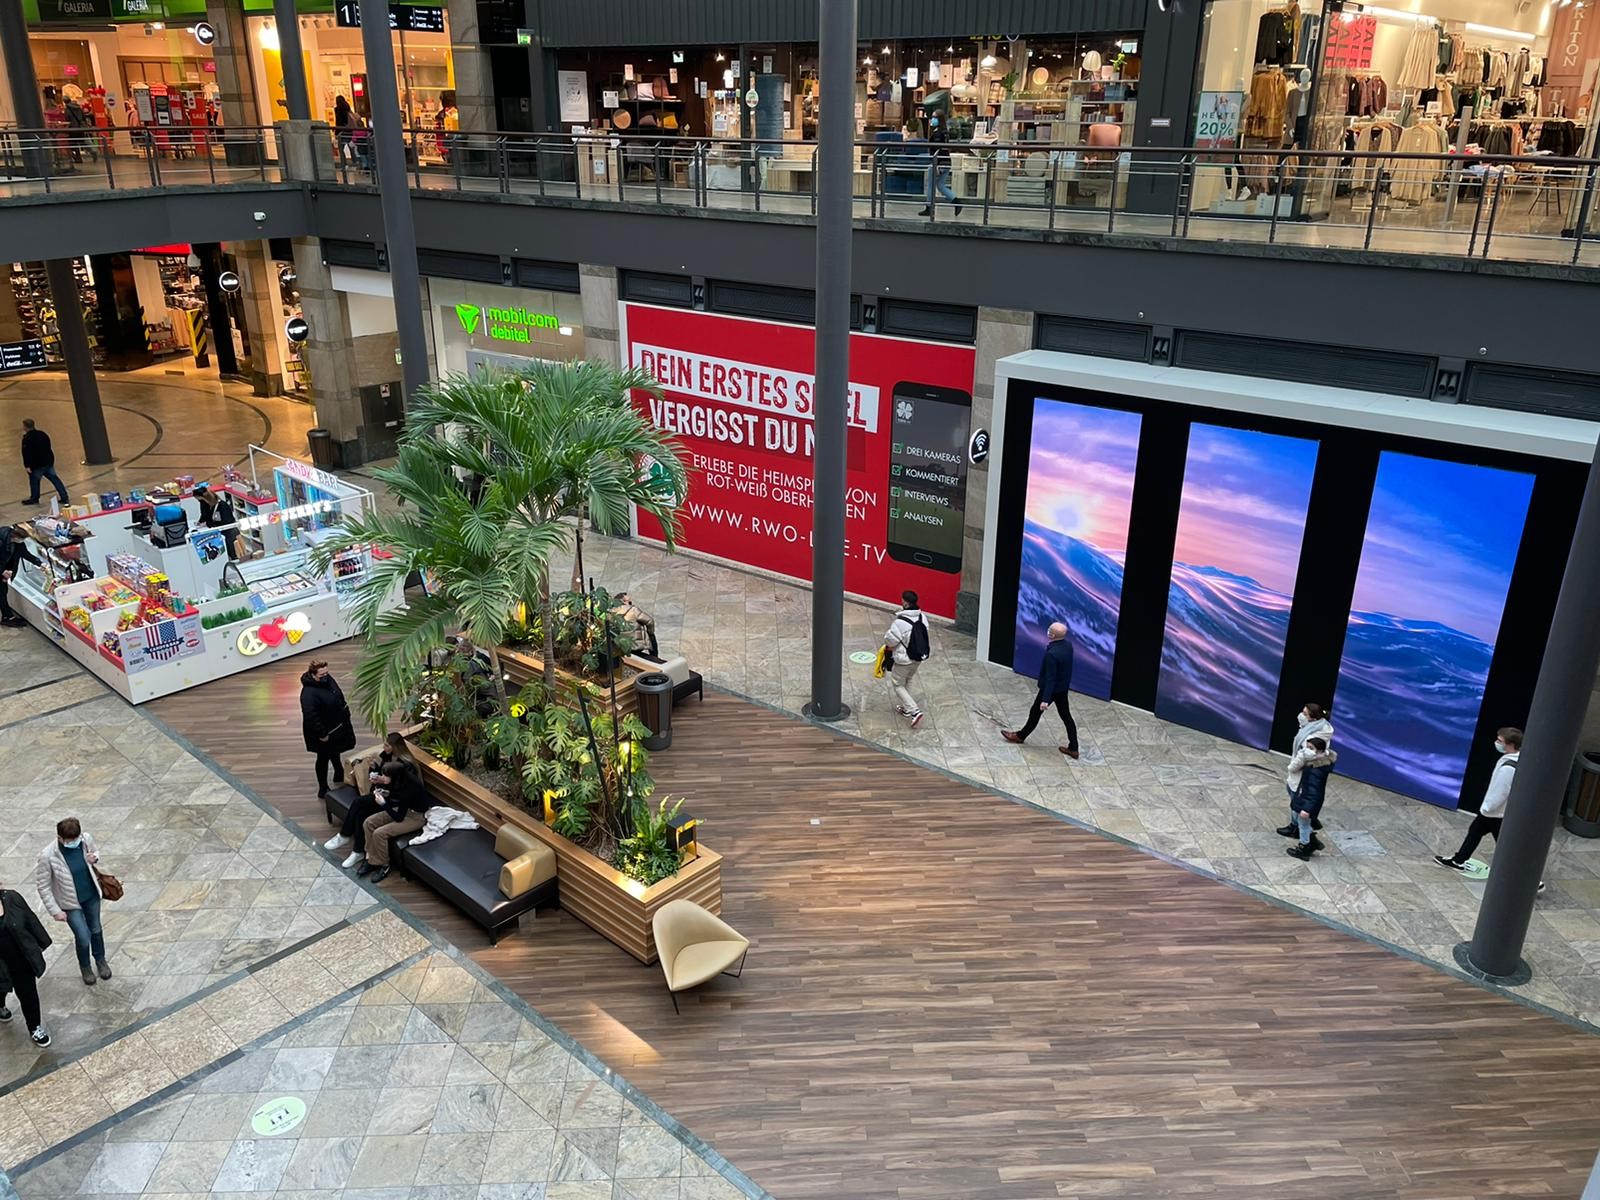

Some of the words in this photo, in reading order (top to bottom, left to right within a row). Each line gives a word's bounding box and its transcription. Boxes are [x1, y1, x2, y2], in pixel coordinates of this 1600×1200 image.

[64, 2, 95, 13] GALERIA
[127, 0, 149, 11] GALERIA
[340, 4, 351, 24] 1
[1360, 18, 1377, 68] SALE
[1199, 121, 1234, 136] 20%
[489, 306, 559, 330] mobilcom
[491, 323, 531, 344] debitel
[641, 349, 692, 389] DEIN
[700, 360, 788, 409] ERSTES
[648, 398, 759, 447] VERGISST
[765, 417, 798, 454] DU
[906, 446, 923, 457] DREI
[924, 449, 961, 464] KAMERAS
[693, 454, 734, 475] ERLEBE
[738, 463, 758, 481] DIE
[905, 468, 959, 486] KOMMENTIERT
[317, 469, 338, 489] BAR
[904, 490, 949, 506] INTERVIEWS
[903, 511, 944, 527] ANALYSEN
